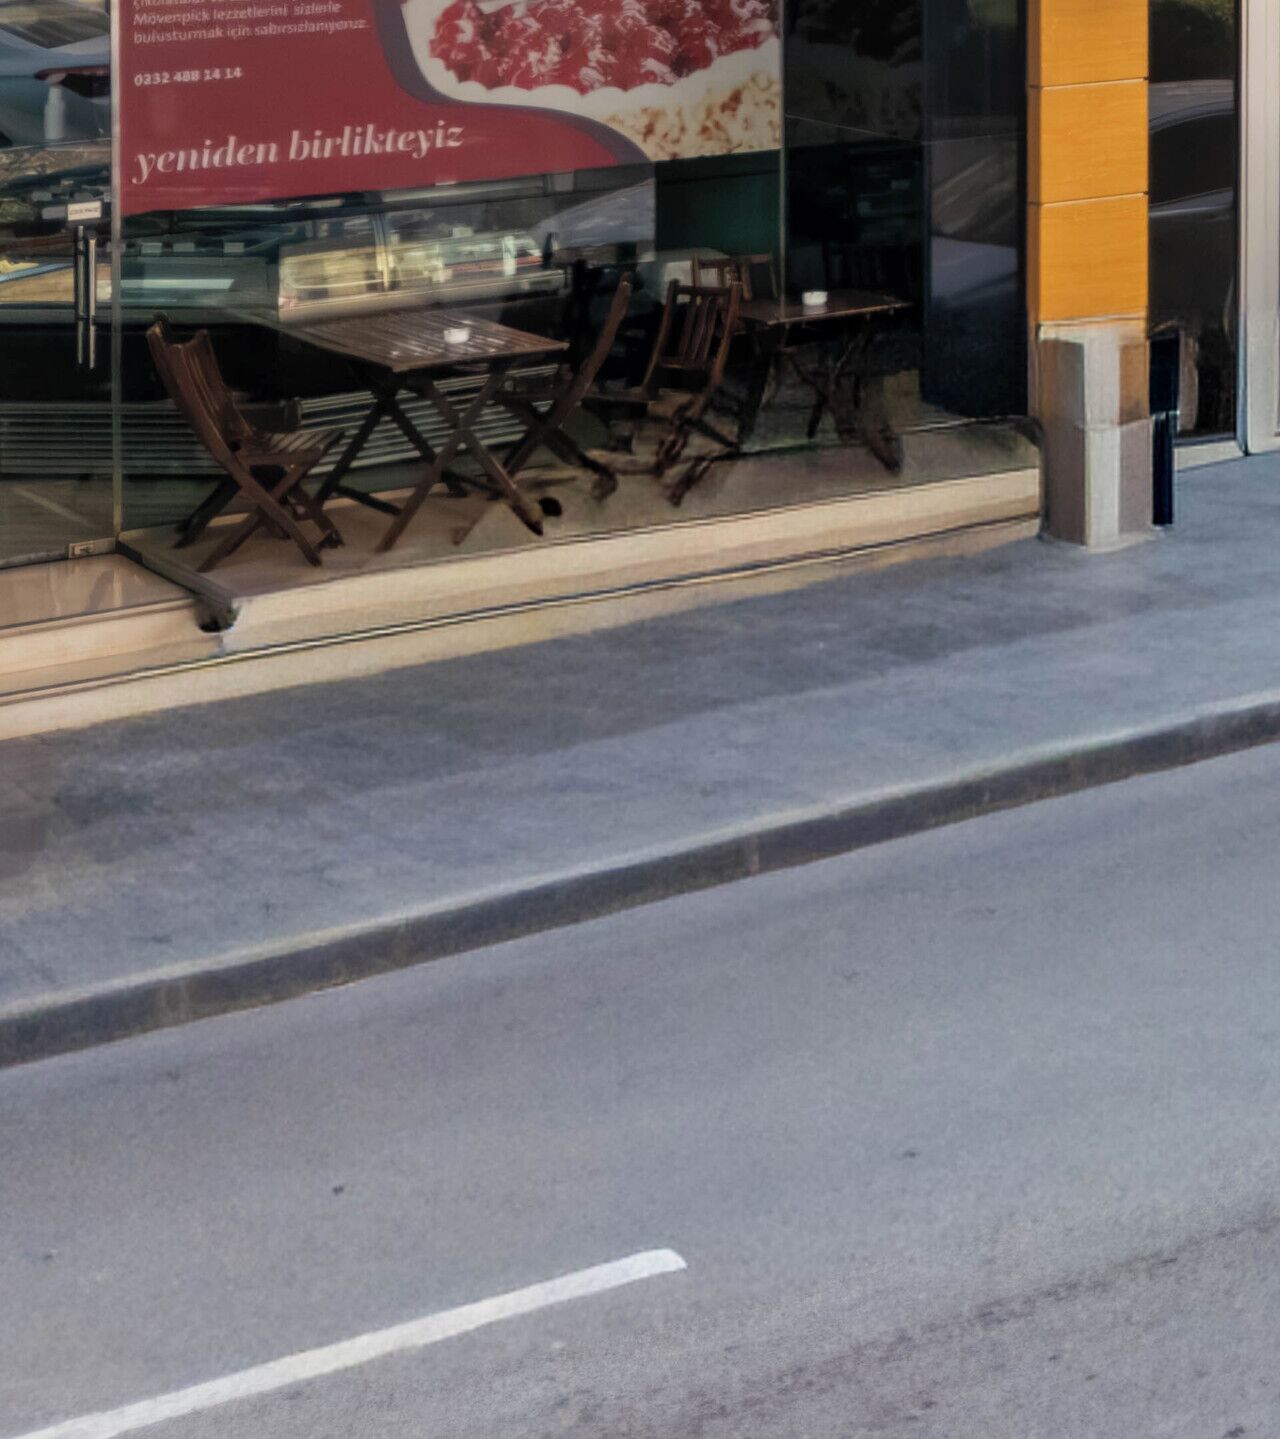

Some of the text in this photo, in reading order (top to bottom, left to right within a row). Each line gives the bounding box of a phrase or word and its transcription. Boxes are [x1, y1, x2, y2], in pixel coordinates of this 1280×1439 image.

[134, 71, 171, 87] 0232
[203, 68, 221, 81] 14
[223, 67, 243, 79] 14
[131, 119, 466, 185] yeniden birlikteyiz
